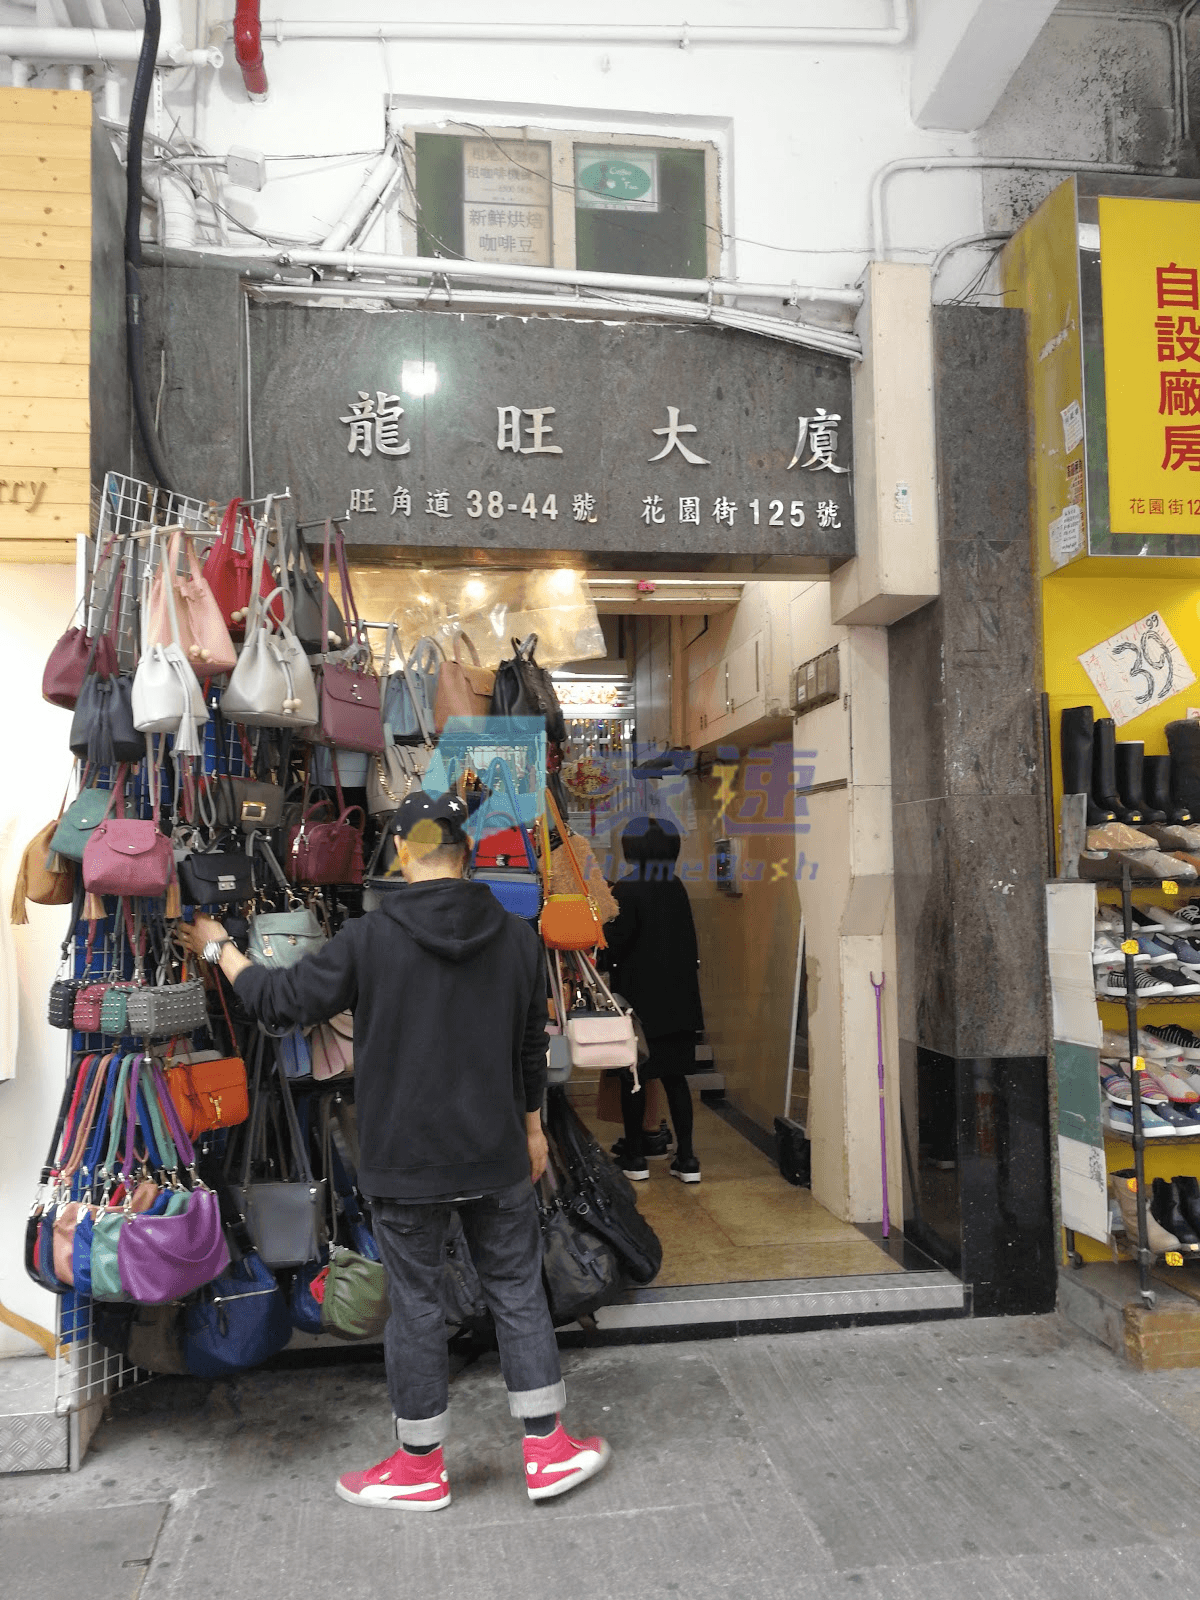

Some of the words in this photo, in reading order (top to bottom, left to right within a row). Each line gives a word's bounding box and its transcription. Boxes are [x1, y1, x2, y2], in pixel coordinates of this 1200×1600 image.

[469, 209, 544, 230] 新鮮烘焙
[479, 234, 536, 253] 咖啡豆
[1154, 262, 1200, 472] 自設廠房
[339, 390, 850, 474] 龍旺大廈
[1111, 629, 1174, 705] 39
